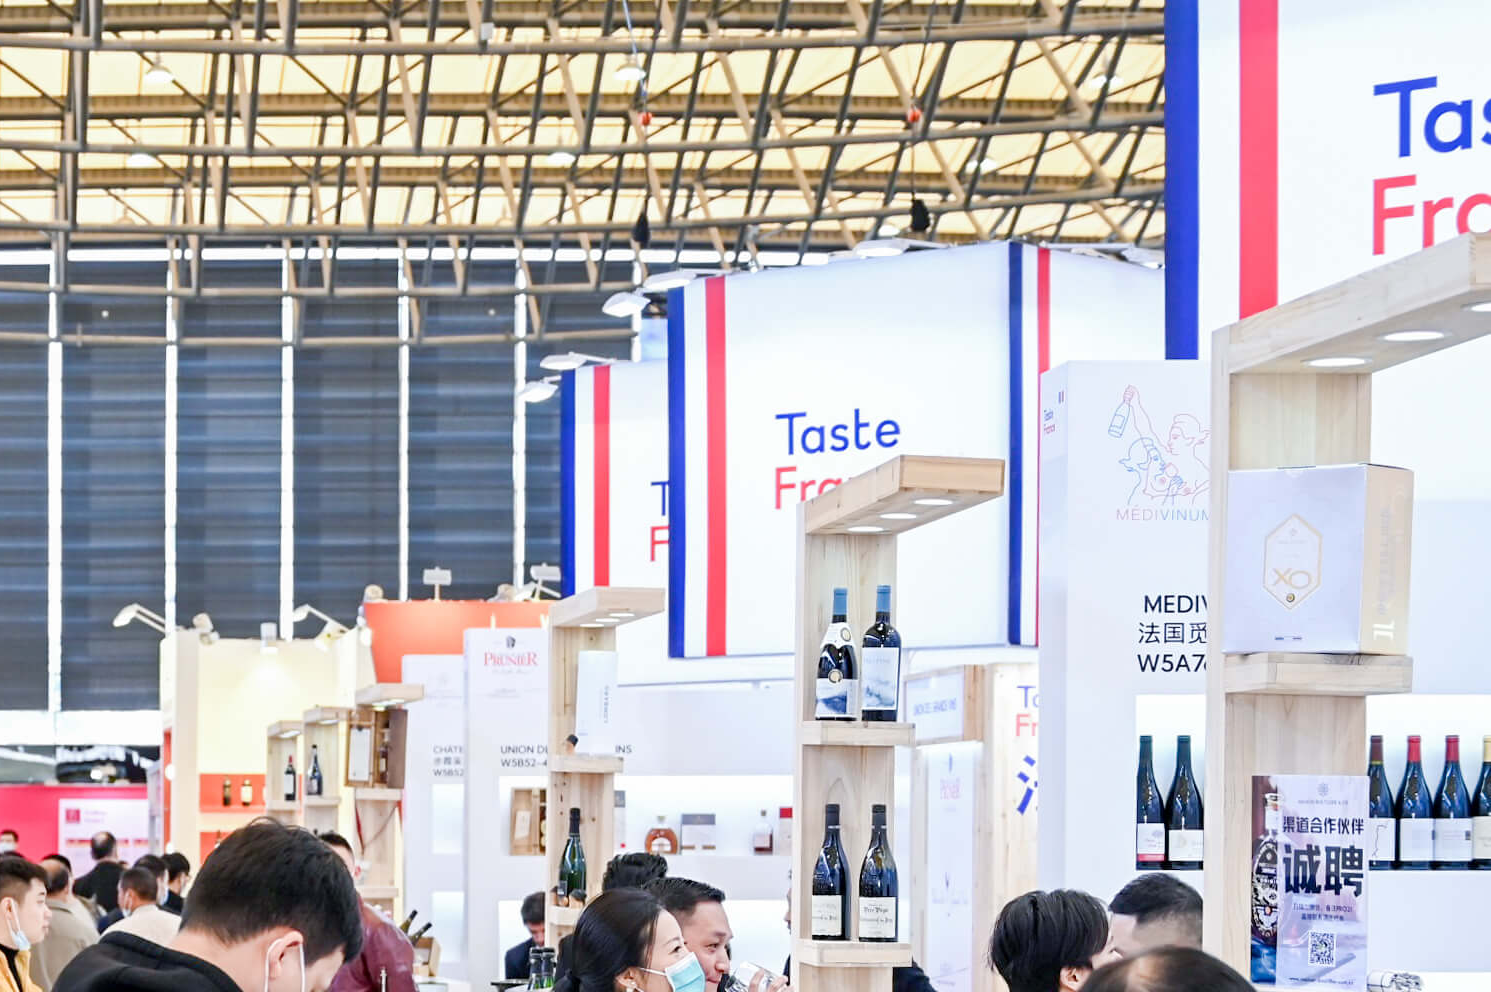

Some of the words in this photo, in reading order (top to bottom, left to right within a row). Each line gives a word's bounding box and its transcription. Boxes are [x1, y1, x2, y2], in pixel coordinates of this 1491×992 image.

[775, 408, 901, 455] Taste
[501, 745, 534, 754] UNION
[1282, 815, 1365, 835] 渠道合作伙伴
[1282, 843, 1364, 898] 诚聘
